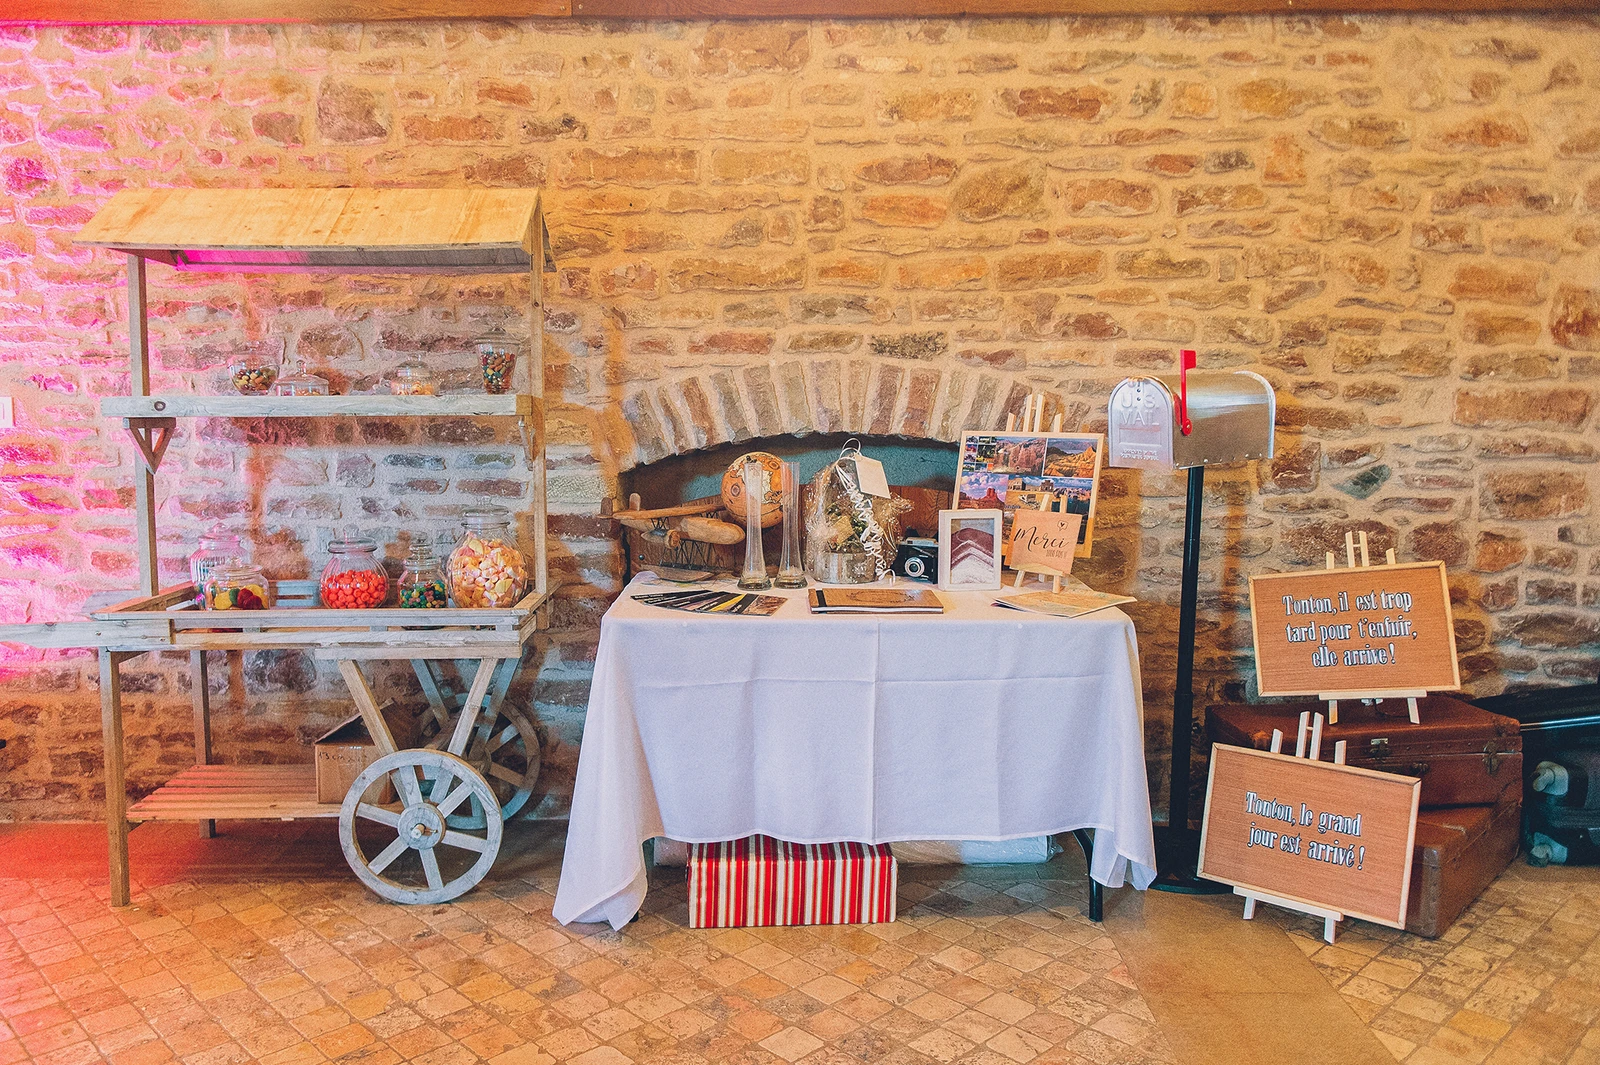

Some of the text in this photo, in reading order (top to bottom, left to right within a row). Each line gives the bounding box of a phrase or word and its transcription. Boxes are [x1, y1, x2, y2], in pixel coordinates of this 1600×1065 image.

[1013, 526, 1070, 552] Merci
[1282, 589, 1412, 616] Tonton, il est trop
[1286, 621, 1316, 643] tard
[1319, 624, 1352, 644] pour
[1312, 646, 1338, 667] elle
[1245, 791, 1362, 837] Tonton, le grand
[1247, 822, 1278, 847] jour
[1279, 833, 1302, 855] est
